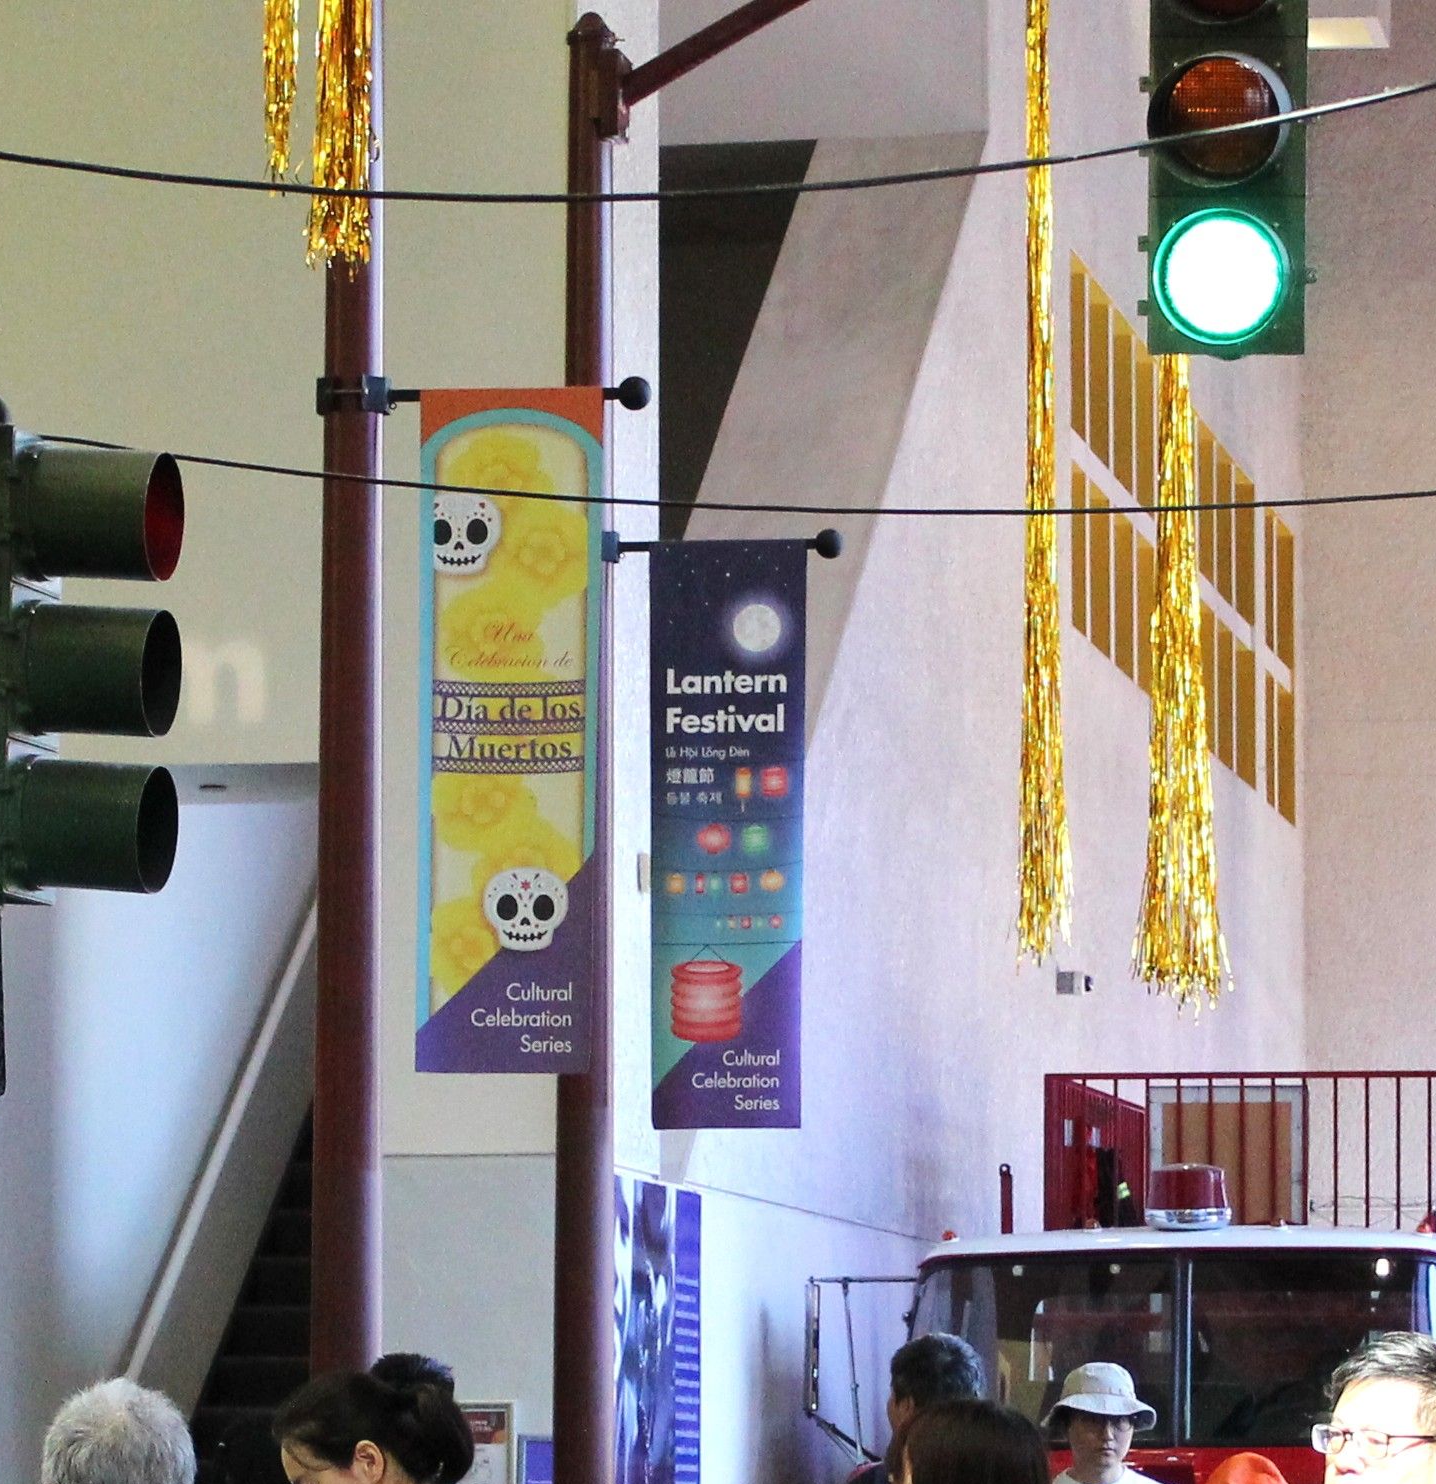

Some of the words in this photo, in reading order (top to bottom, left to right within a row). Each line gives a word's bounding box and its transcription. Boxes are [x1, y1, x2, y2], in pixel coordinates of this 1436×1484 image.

[553, 650, 573, 668] de
[666, 668, 787, 695] Lantern
[441, 695, 488, 720] Día
[499, 696, 532, 721] de
[541, 696, 582, 720] los
[666, 703, 785, 734] Festival
[448, 735, 573, 760] Muertos
[506, 982, 573, 1002] Cultural
[471, 1008, 573, 1028] Celebration
[520, 1034, 573, 1054] Series
[722, 1049, 781, 1067] Cultural
[692, 1072, 780, 1090] Celebration
[733, 1094, 781, 1112] Series
